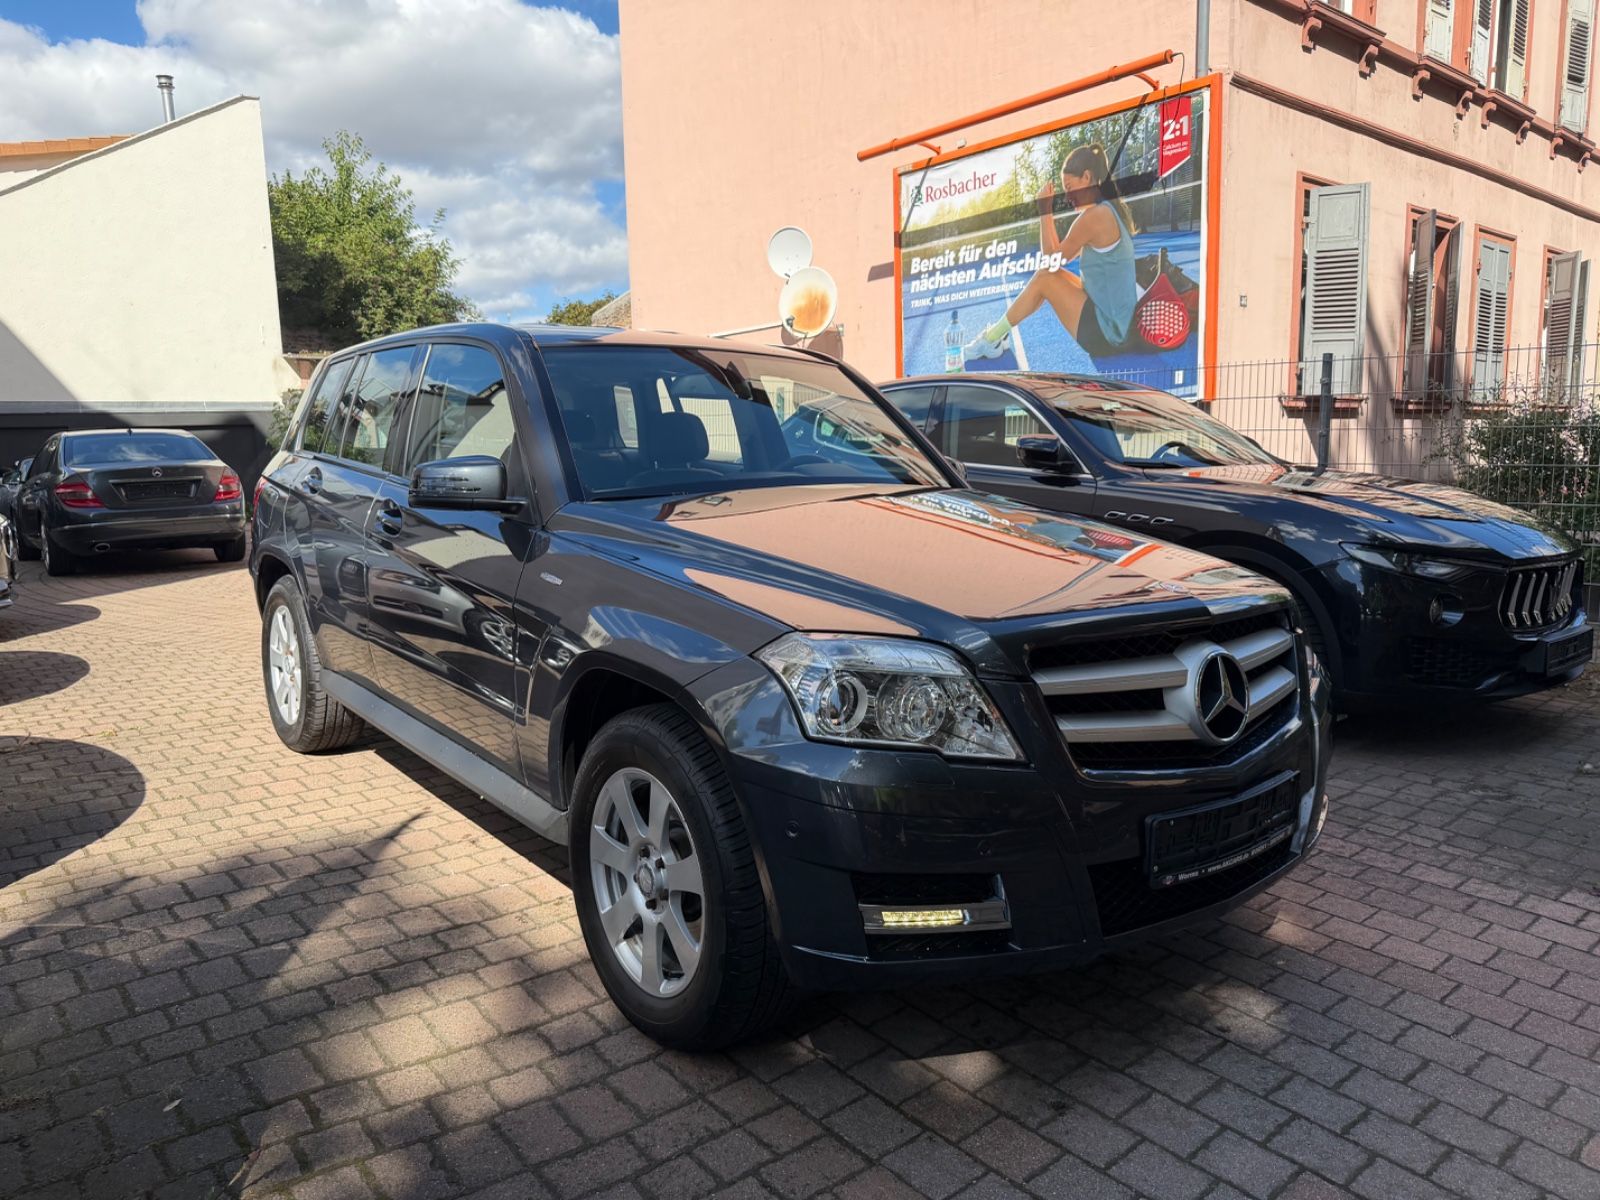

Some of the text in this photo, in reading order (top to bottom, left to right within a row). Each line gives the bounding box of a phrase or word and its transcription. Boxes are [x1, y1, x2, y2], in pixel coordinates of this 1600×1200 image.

[1163, 115, 1189, 141] 2:1
[925, 171, 997, 203] Rosbacher
[910, 251, 1067, 293] nächsten Aufschlag.
[911, 239, 1018, 275] Bereit für den
[910, 280, 1026, 309] TRINK, WAS DICH WEITERBRINGT.
